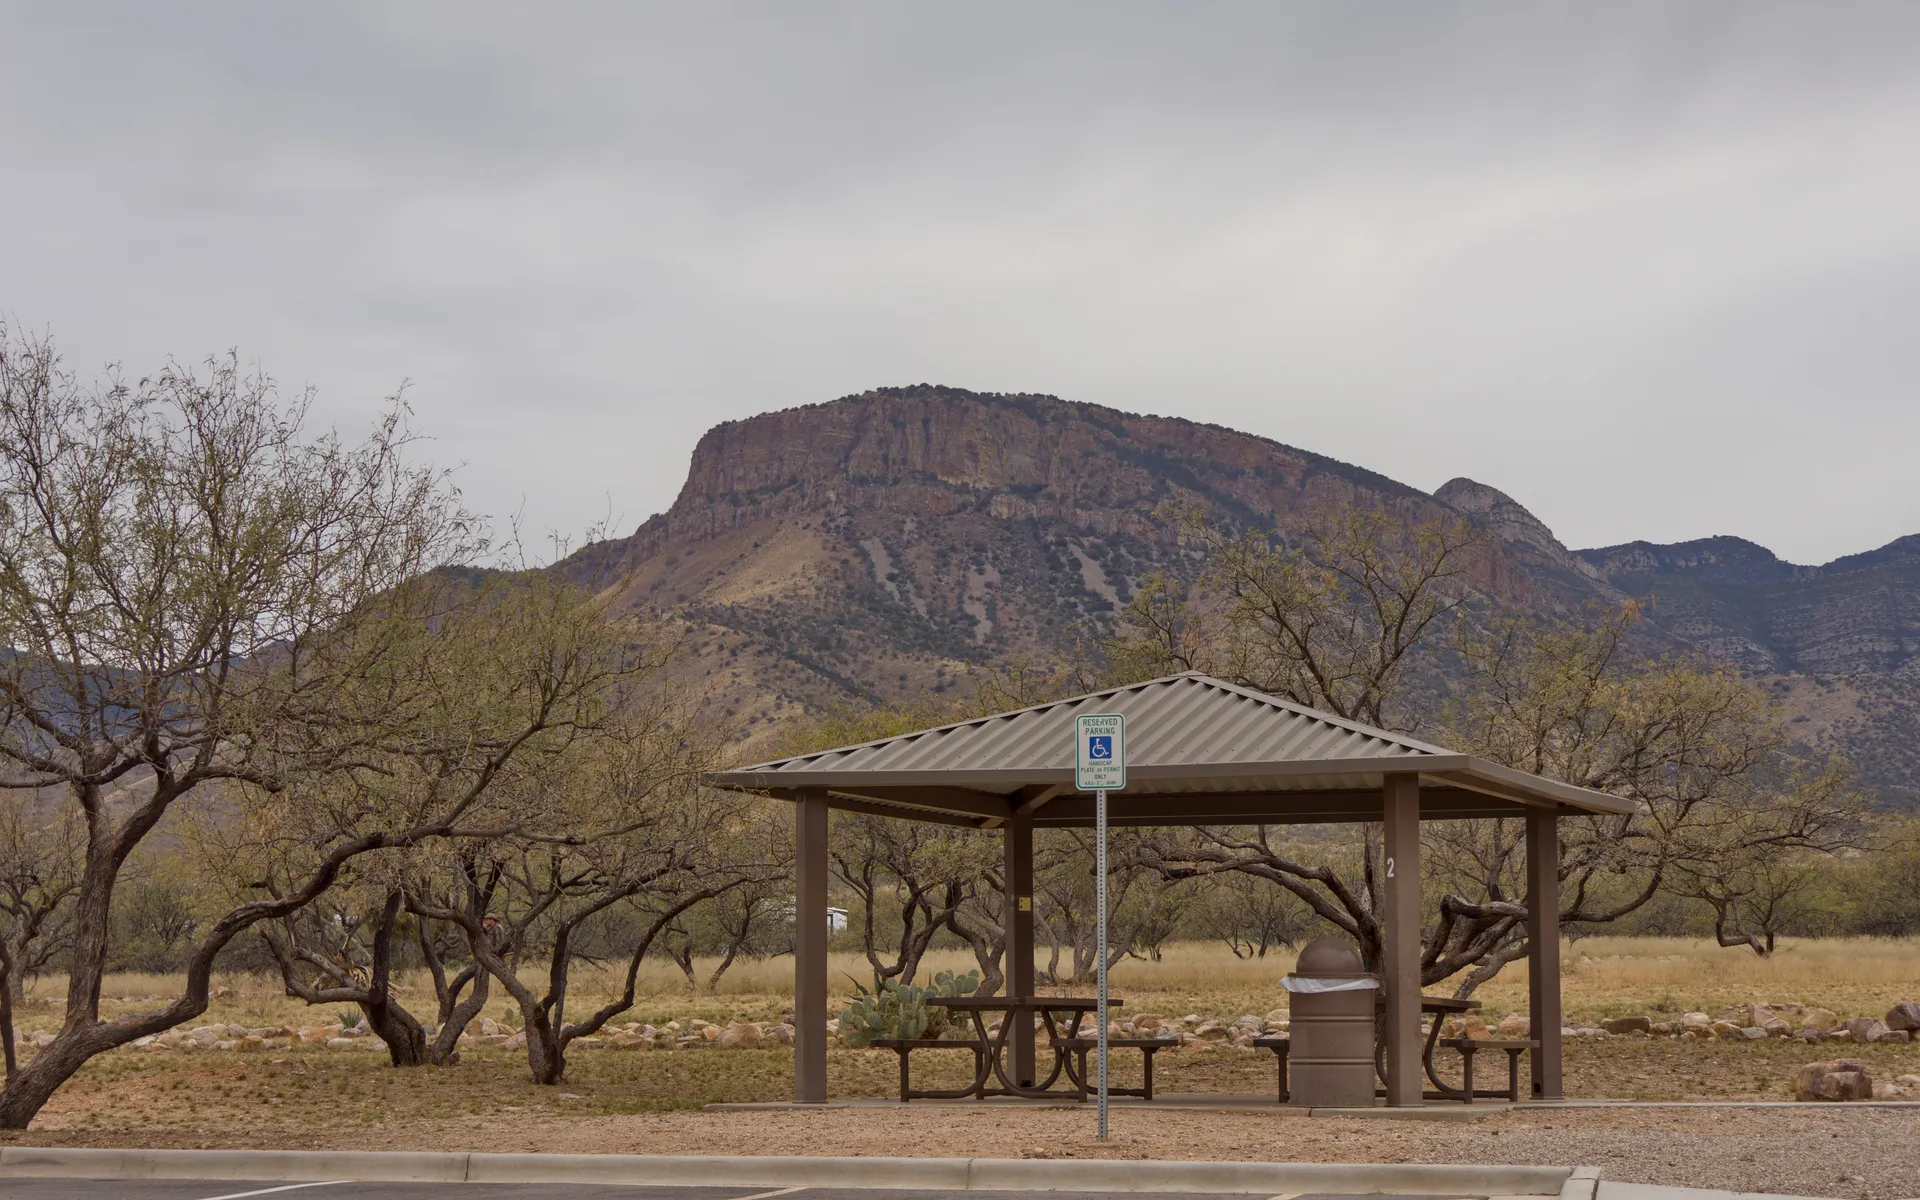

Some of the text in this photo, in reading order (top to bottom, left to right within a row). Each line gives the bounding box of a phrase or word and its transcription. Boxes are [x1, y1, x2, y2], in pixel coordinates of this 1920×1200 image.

[1082, 718, 1118, 726] RESERVED
[1085, 727, 1115, 735] PARKING
[1387, 857, 1394, 878] 2
